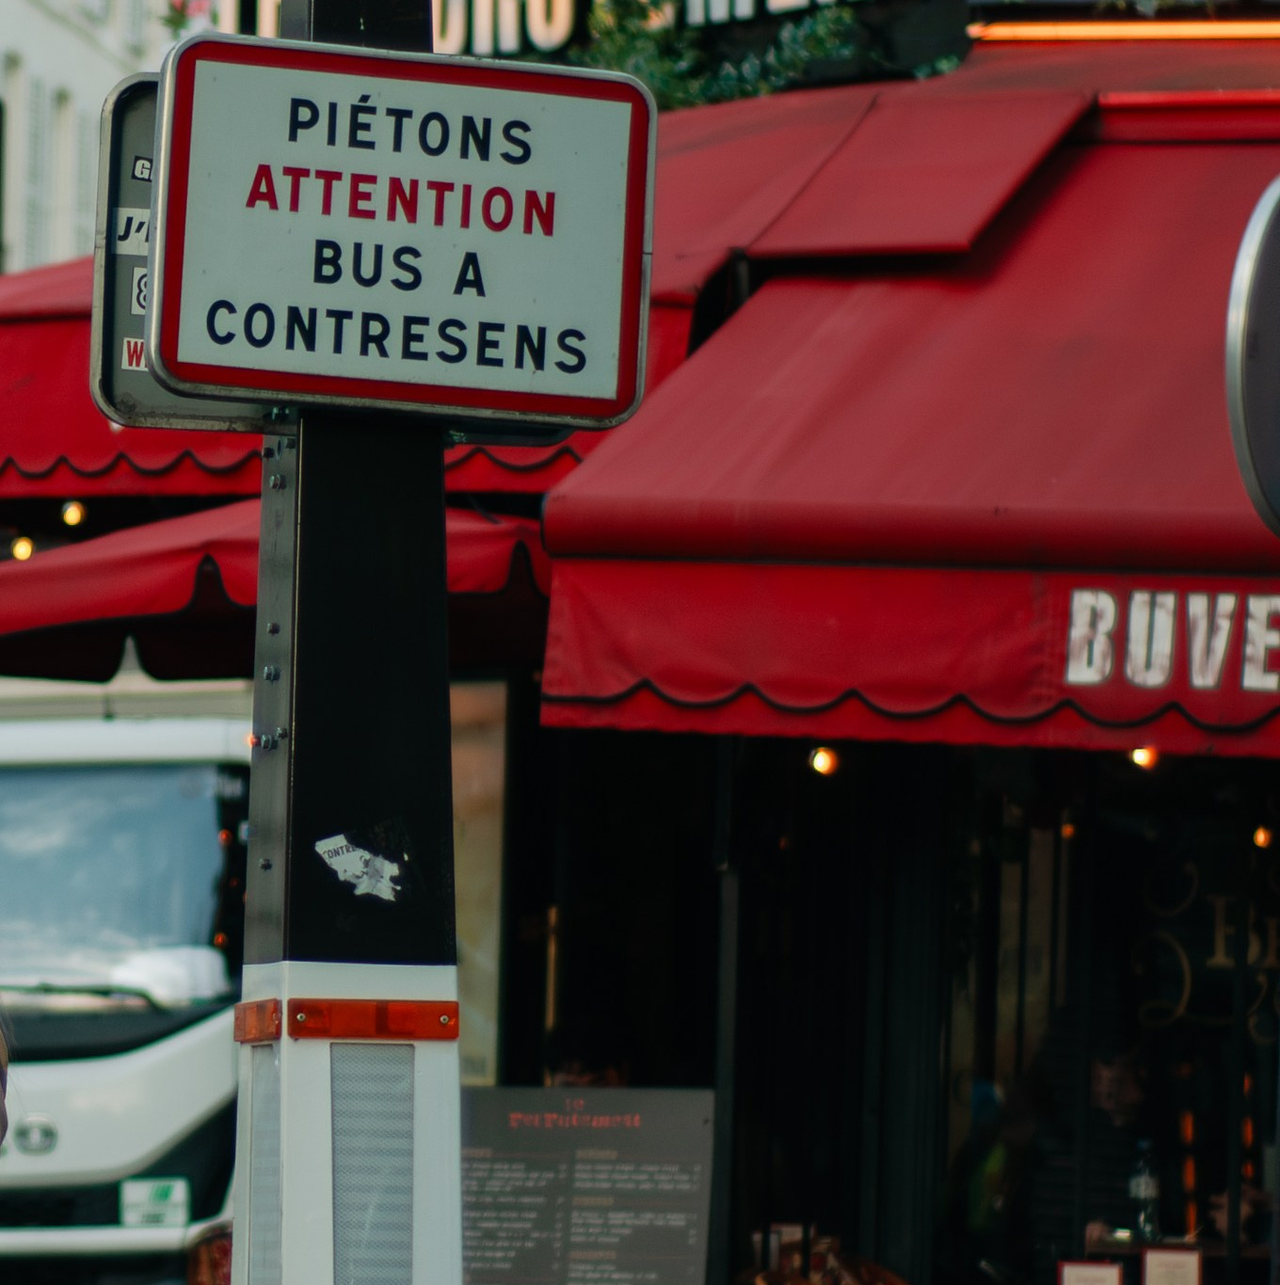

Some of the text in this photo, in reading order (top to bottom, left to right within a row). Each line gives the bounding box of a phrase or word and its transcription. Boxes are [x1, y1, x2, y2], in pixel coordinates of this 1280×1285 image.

[288, 94, 532, 165] PIÉTONS
[245, 163, 556, 237] ATTENTION
[313, 239, 486, 297] BUS A
[206, 300, 587, 374] CONTRESENS
[1066, 589, 1280, 690] BUVE
